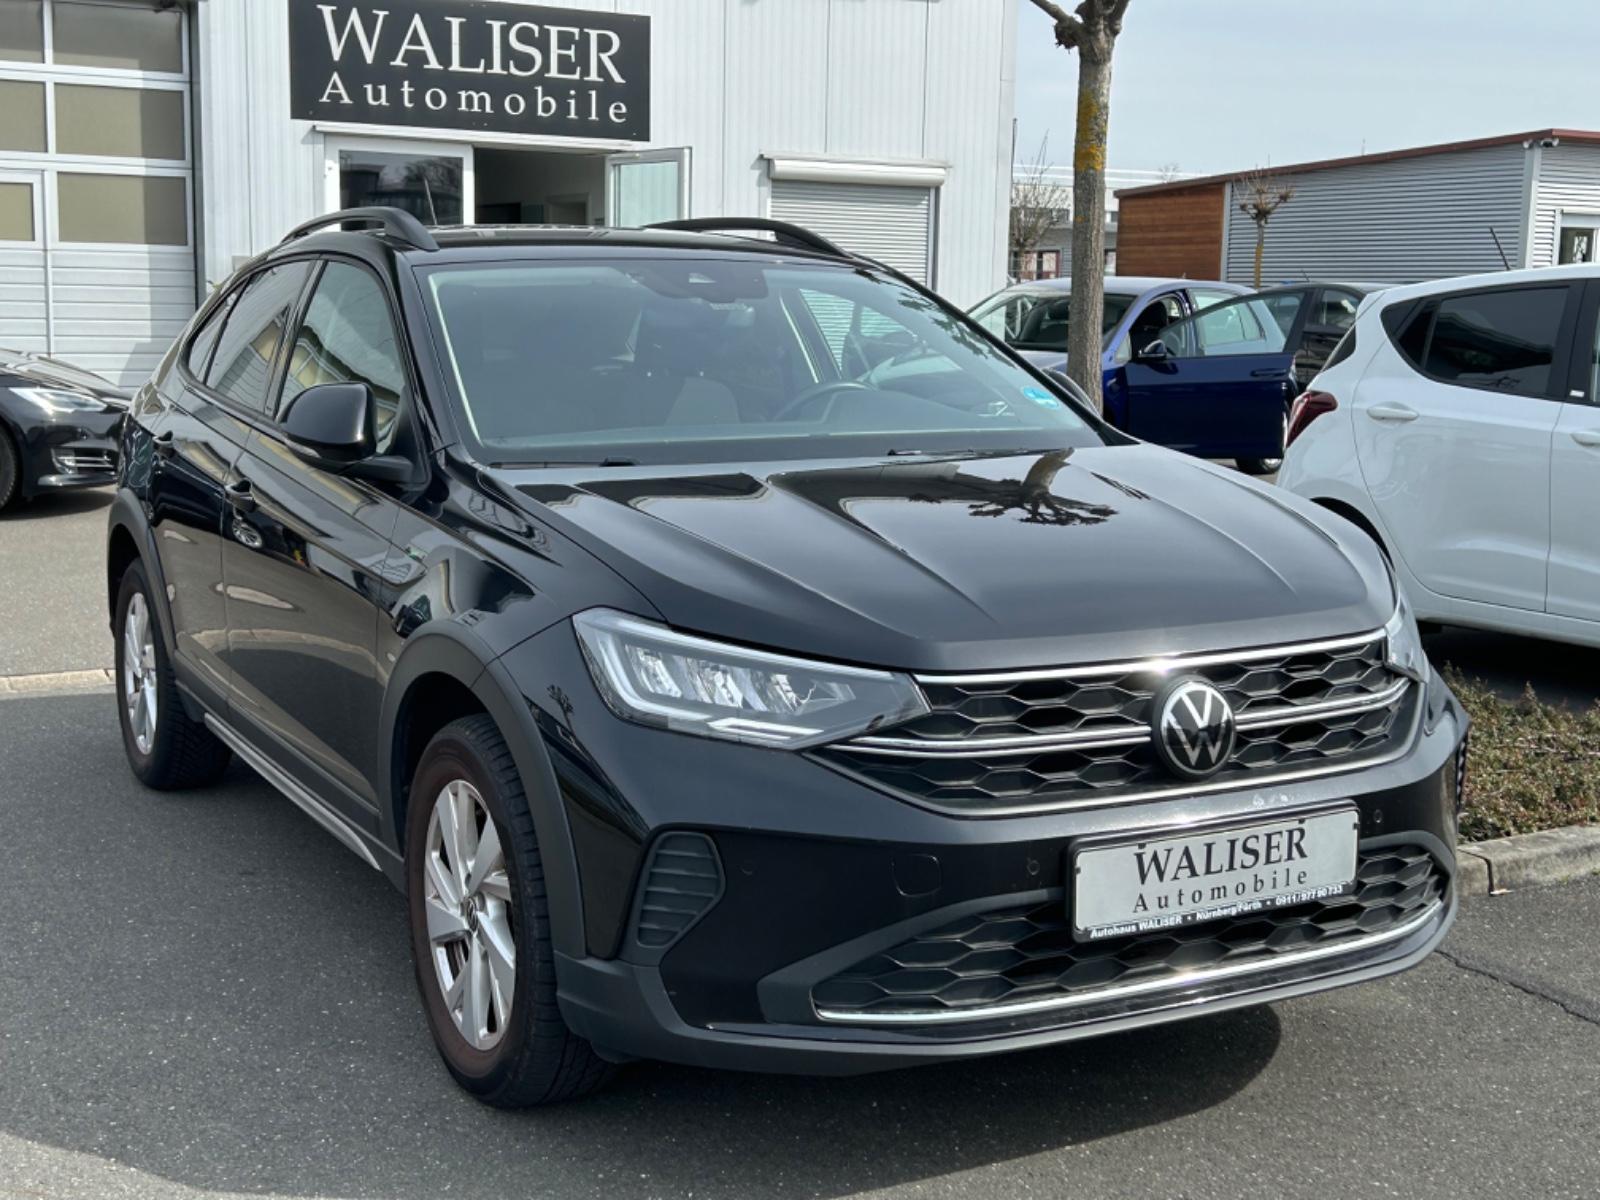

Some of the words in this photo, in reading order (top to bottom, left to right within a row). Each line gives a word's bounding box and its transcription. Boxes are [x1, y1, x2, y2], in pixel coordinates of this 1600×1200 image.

[317, 4, 627, 84] WALISER
[319, 71, 628, 123] Automobile
[1133, 827, 1308, 885] WALISER
[1133, 868, 1308, 913] Automobile
[1090, 924, 1137, 938] Autohaus
[1139, 915, 1183, 930] WALISER
